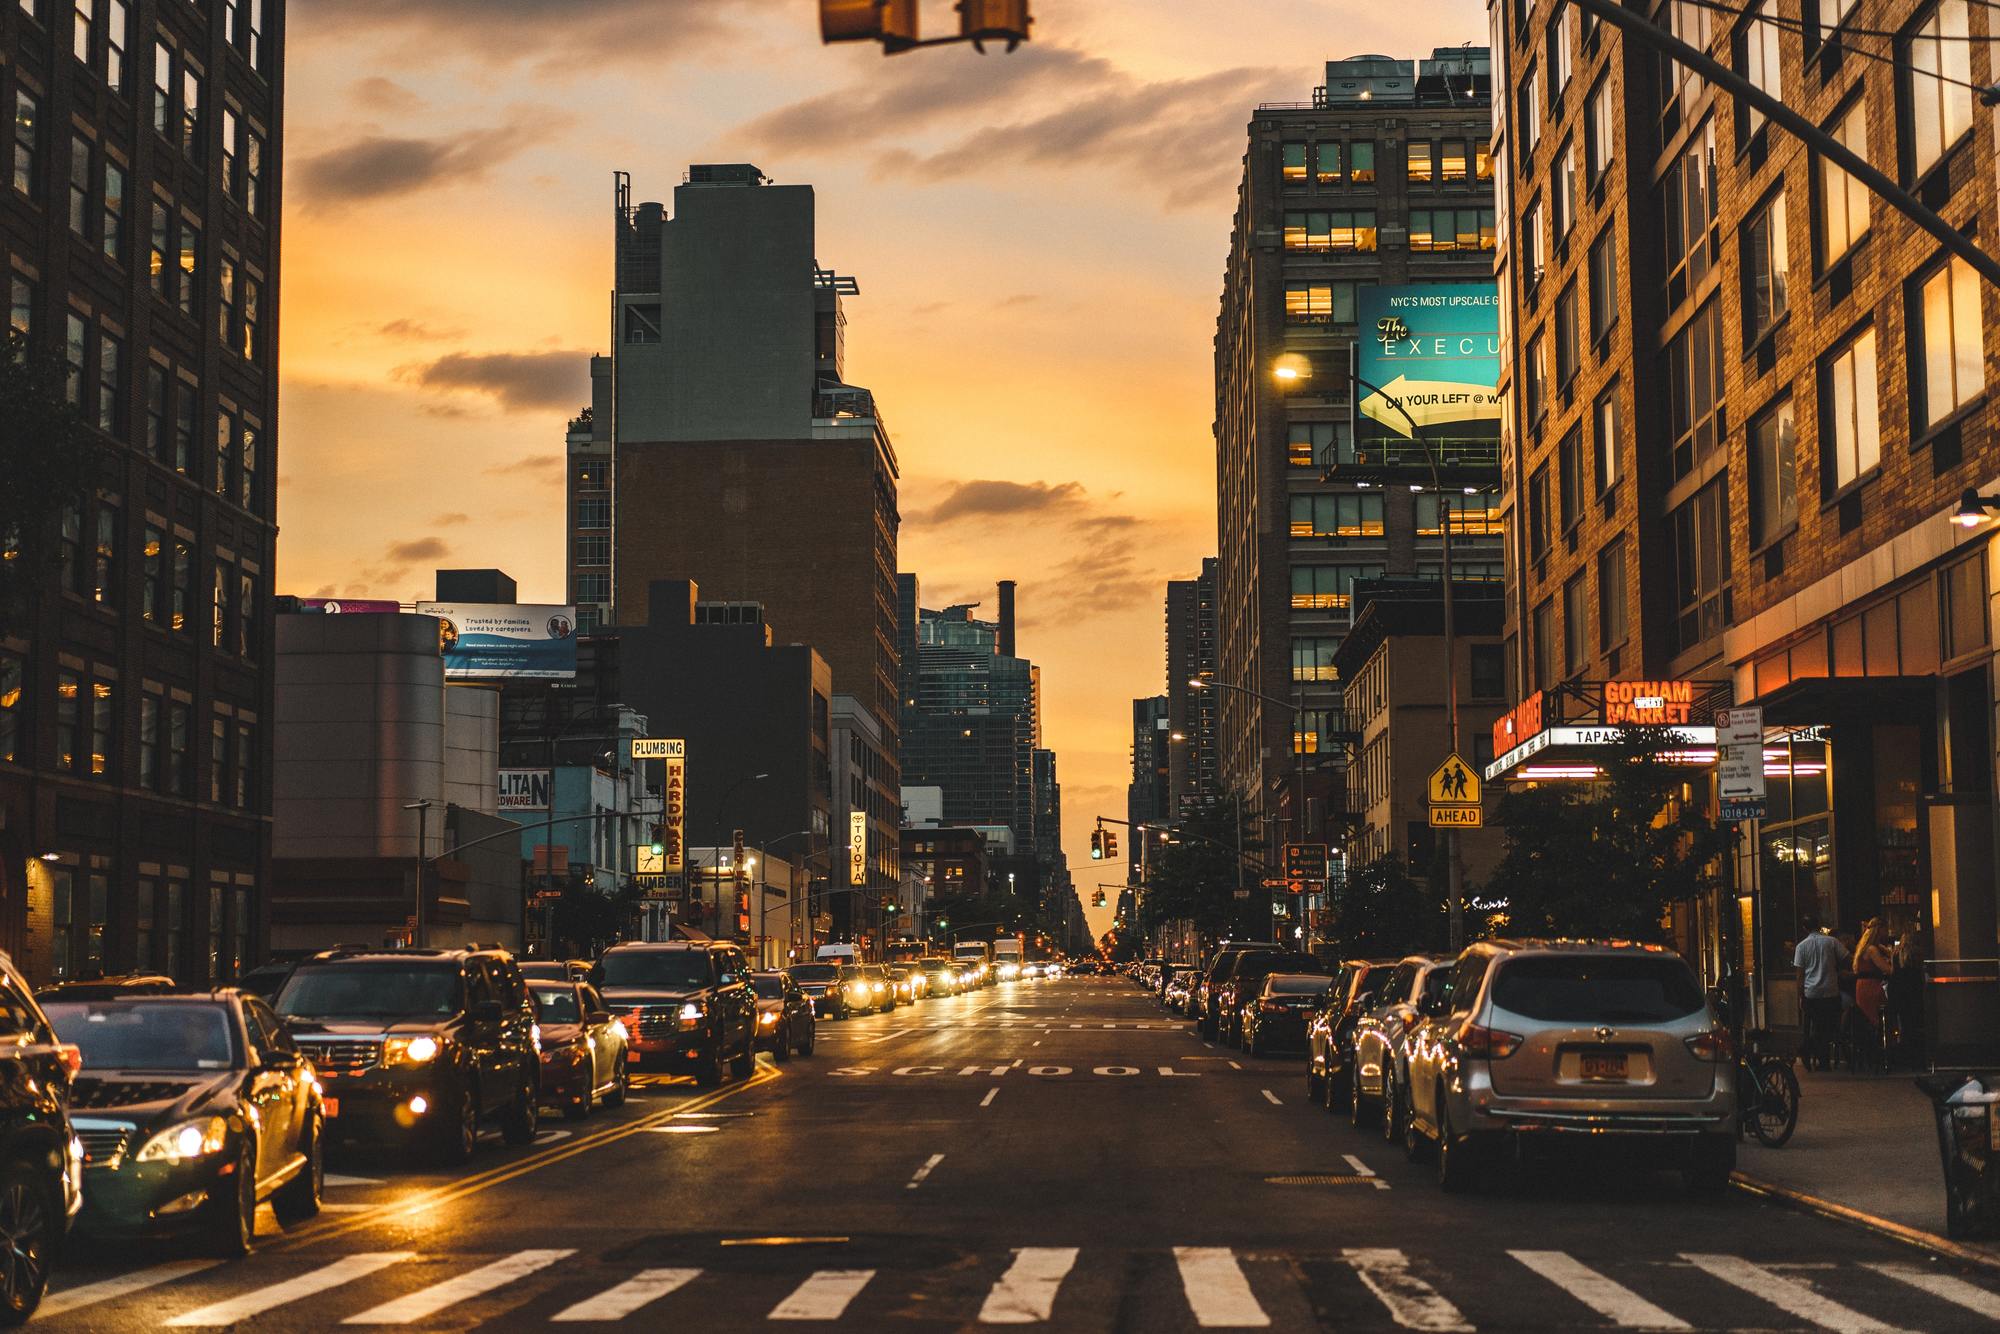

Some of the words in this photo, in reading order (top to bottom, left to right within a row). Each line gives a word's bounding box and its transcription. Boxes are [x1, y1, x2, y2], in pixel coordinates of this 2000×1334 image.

[1390, 297, 1417, 307] NYC'S
[1420, 296, 1447, 306] MOST
[1449, 296, 1489, 306] UPSCALE
[1377, 316, 1406, 342] The
[1384, 338, 1500, 355] EXECU
[1386, 397, 1403, 409] ON
[1406, 395, 1438, 406] YOUR
[1442, 394, 1470, 404] LEFT
[1473, 394, 1483, 403] @
[465, 625, 485, 633] Loved
[1605, 681, 1693, 703] GOTHAM
[1605, 703, 1692, 725] MARKET
[635, 742, 683, 755] PLUMBING
[1721, 747, 1727, 760] 2
[668, 765, 682, 865] HARDWARE
[1436, 810, 1476, 822] AHEAD
[854, 825, 863, 881] TOYOTA
[827, 1065, 1202, 1076] SCHOOL
